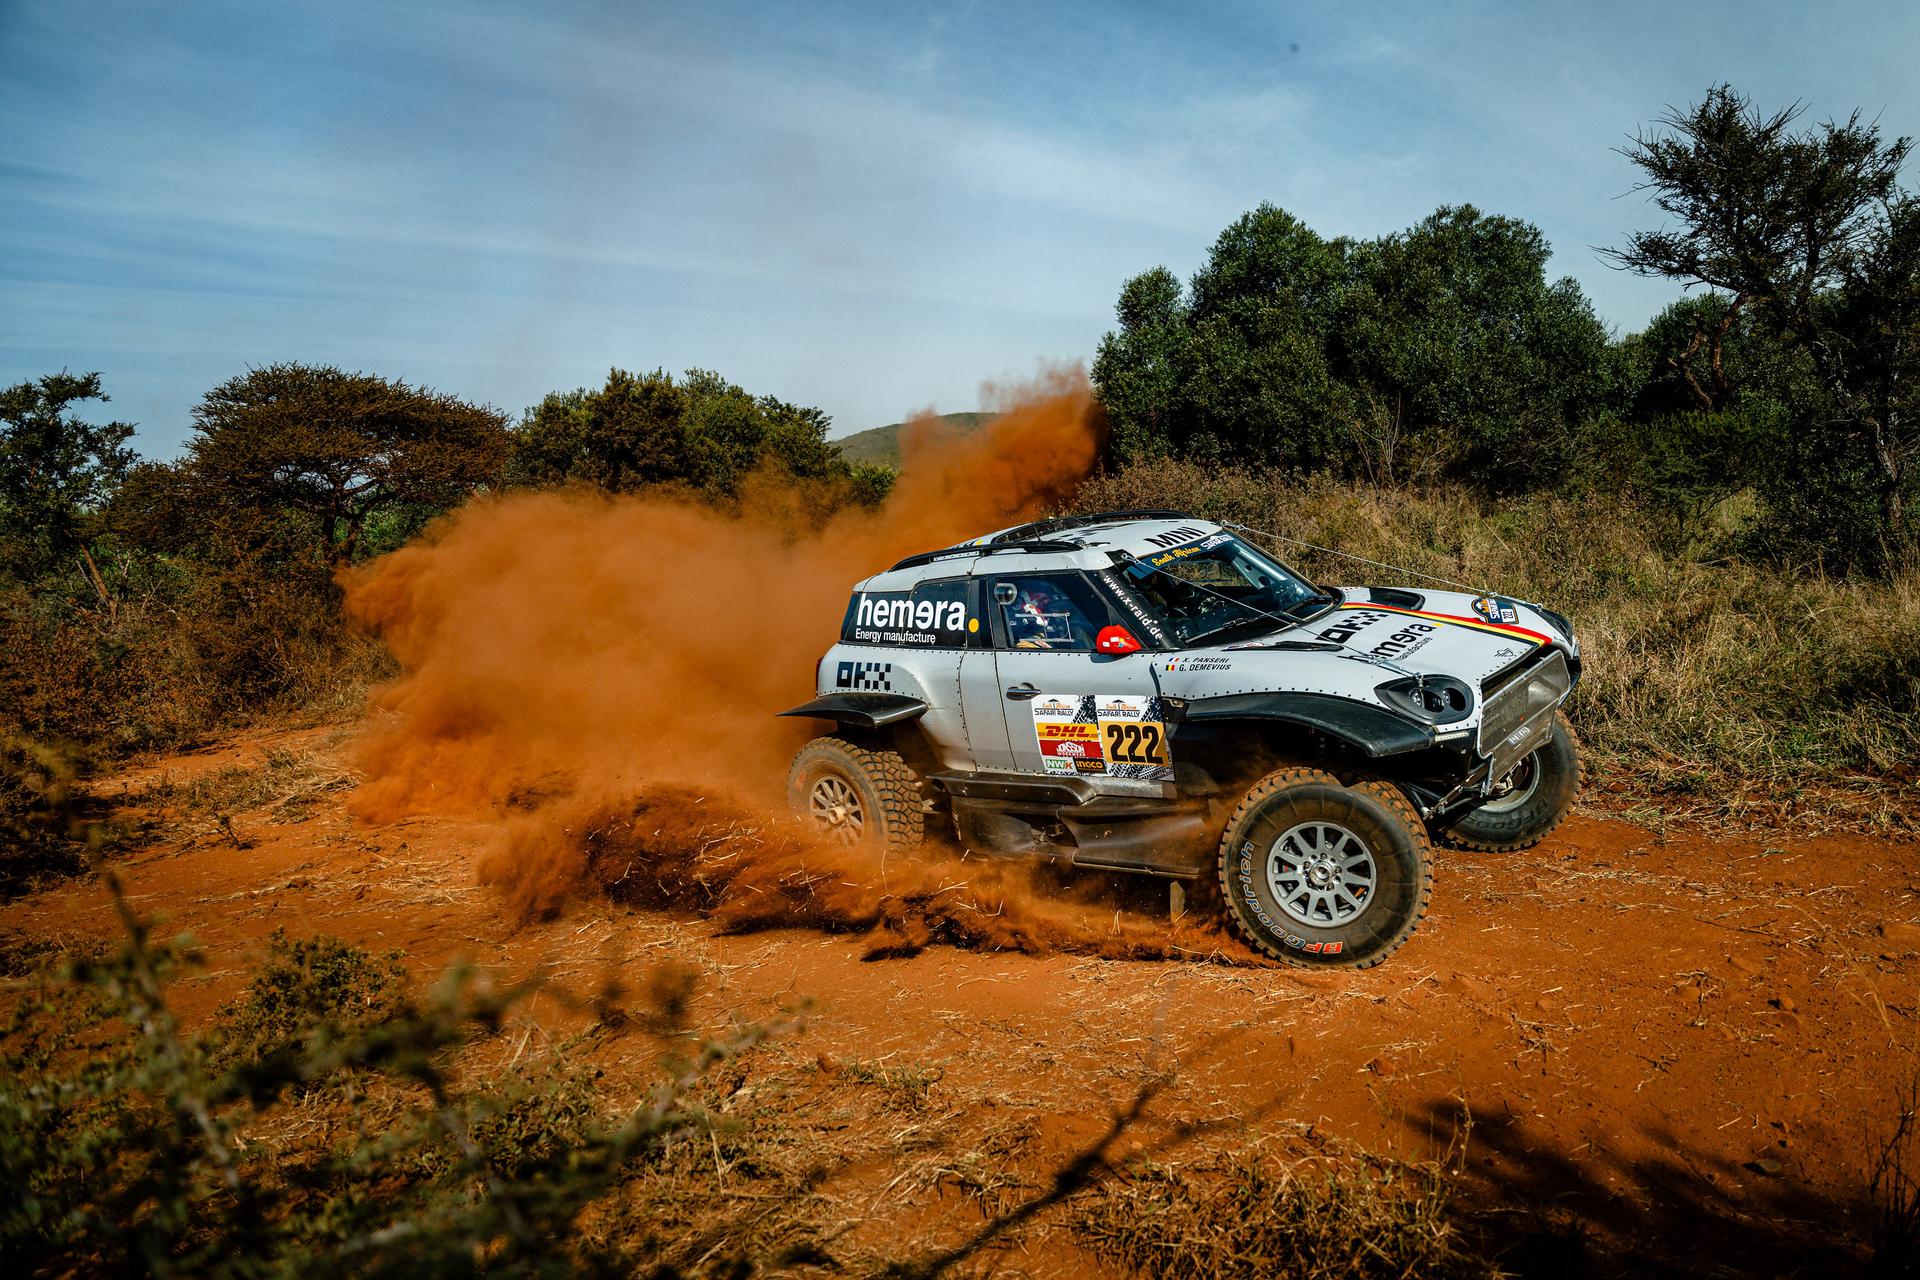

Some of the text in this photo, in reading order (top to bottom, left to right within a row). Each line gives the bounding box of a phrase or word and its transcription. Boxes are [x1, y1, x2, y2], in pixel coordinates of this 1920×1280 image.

[1143, 526, 1207, 548] MINI
[1151, 546, 1201, 567] South African
[1103, 575, 1163, 640] www.x-raid.de
[855, 628, 936, 644] Energy manufacture
[1337, 622, 1437, 665] hmera
[1178, 664, 1187, 672] G.
[1045, 726, 1090, 737] DHL
[1107, 724, 1164, 764] 222
[1239, 842, 1343, 954] BFGoodrich
